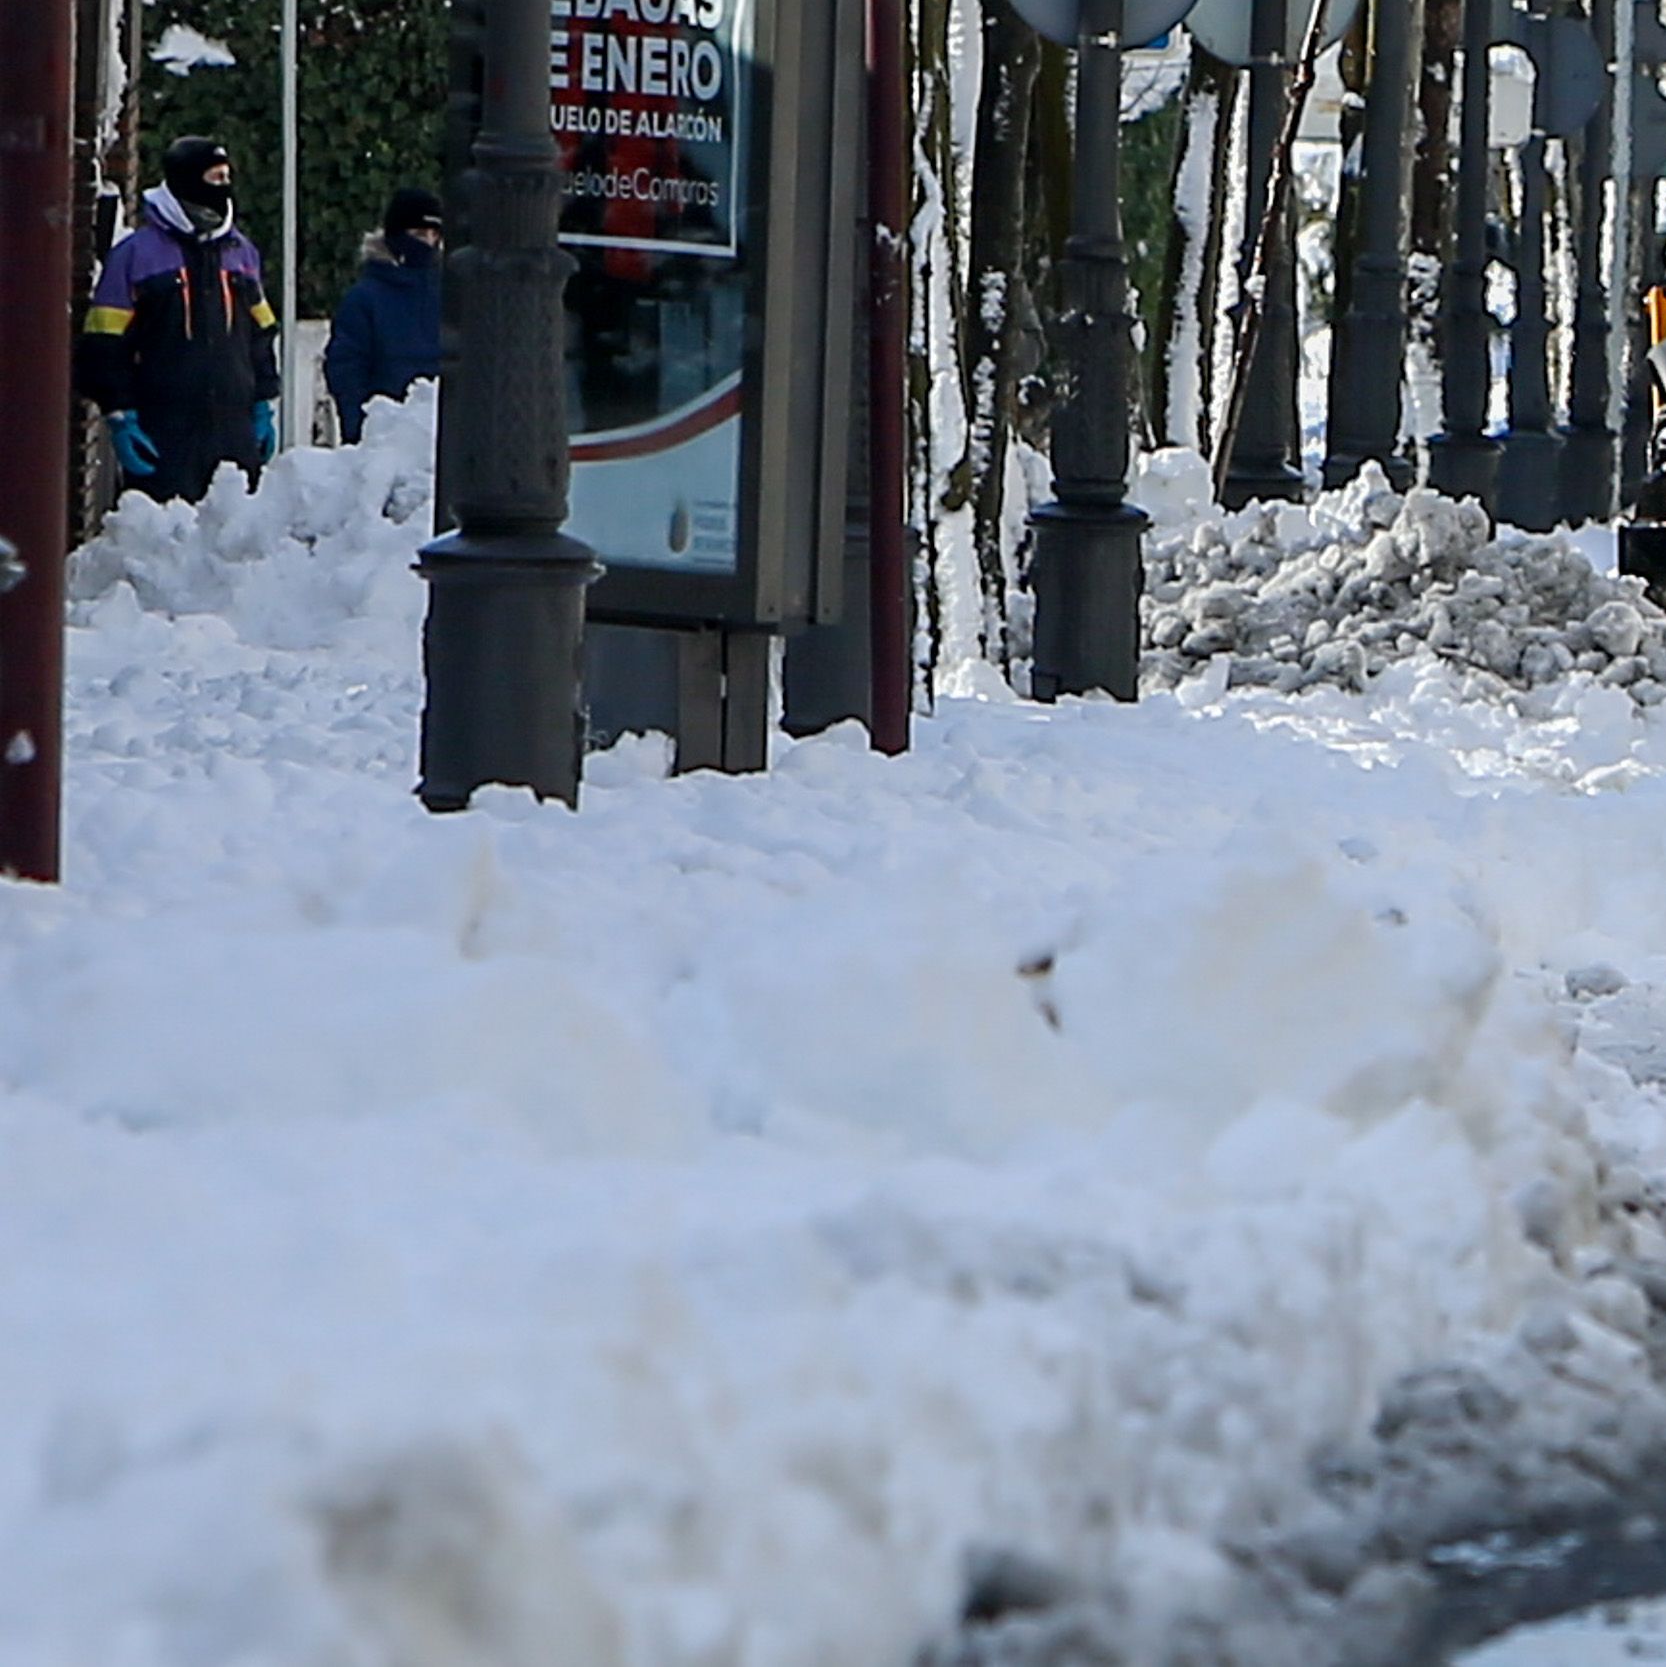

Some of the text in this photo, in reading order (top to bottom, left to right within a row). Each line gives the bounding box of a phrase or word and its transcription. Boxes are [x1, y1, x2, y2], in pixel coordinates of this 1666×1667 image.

[550, 30, 722, 101] E ENERO
[551, 105, 723, 143] UELO DE ALARCÓN
